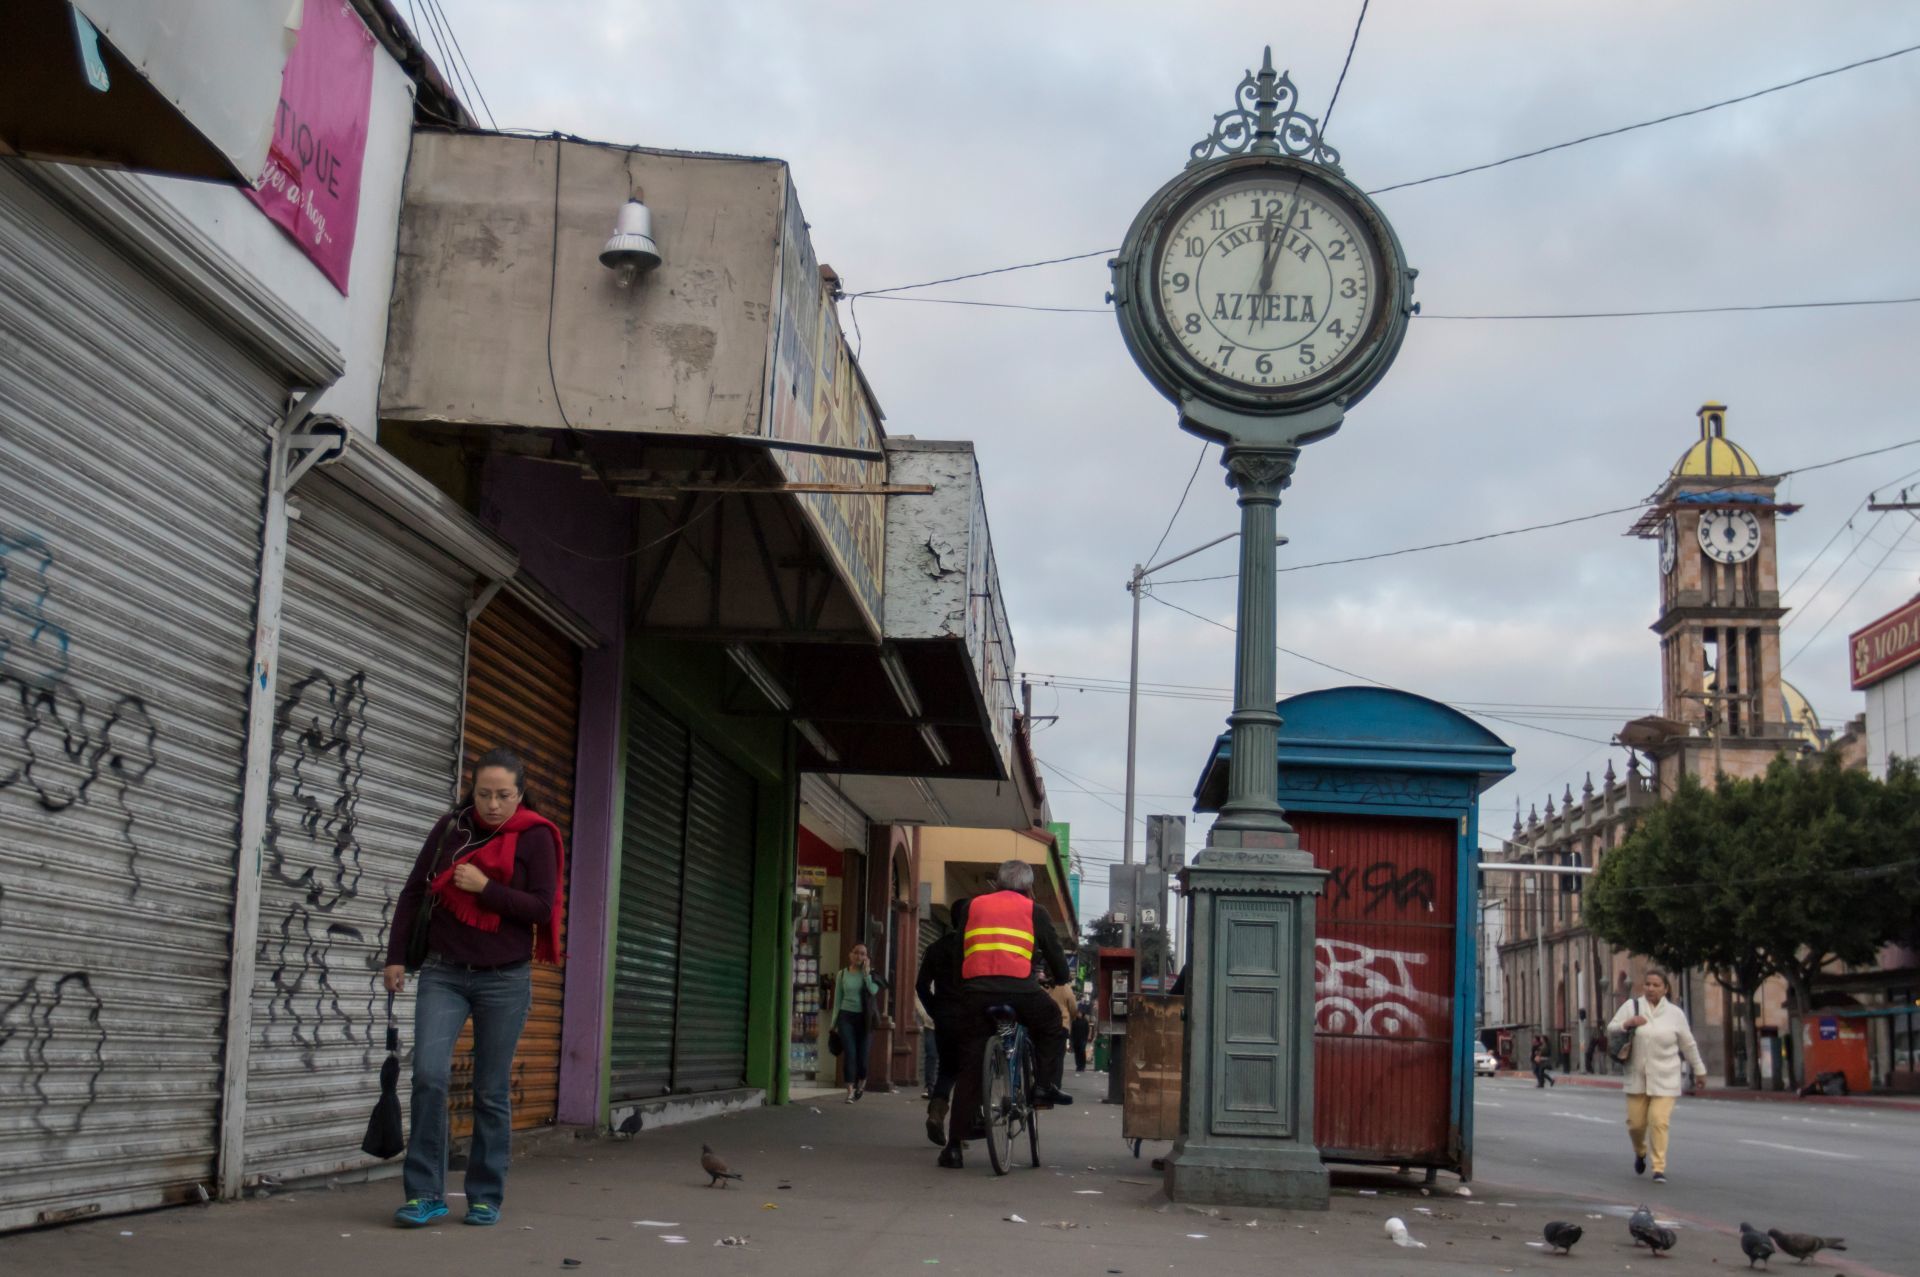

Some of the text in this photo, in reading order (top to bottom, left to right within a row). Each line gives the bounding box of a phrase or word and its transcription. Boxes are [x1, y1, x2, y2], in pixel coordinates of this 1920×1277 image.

[1210, 209, 1226, 231] 11
[1251, 199, 1283, 220] 12
[1299, 209, 1313, 230] 1
[1184, 236, 1205, 258] 10
[1328, 239, 1346, 261] 2
[1172, 272, 1190, 294] 9
[1340, 277, 1358, 299] 3
[1184, 312, 1202, 334] 8
[1326, 318, 1345, 339] 4
[1218, 345, 1236, 366] 7
[1255, 353, 1273, 375] 6
[1298, 344, 1316, 365] 5
